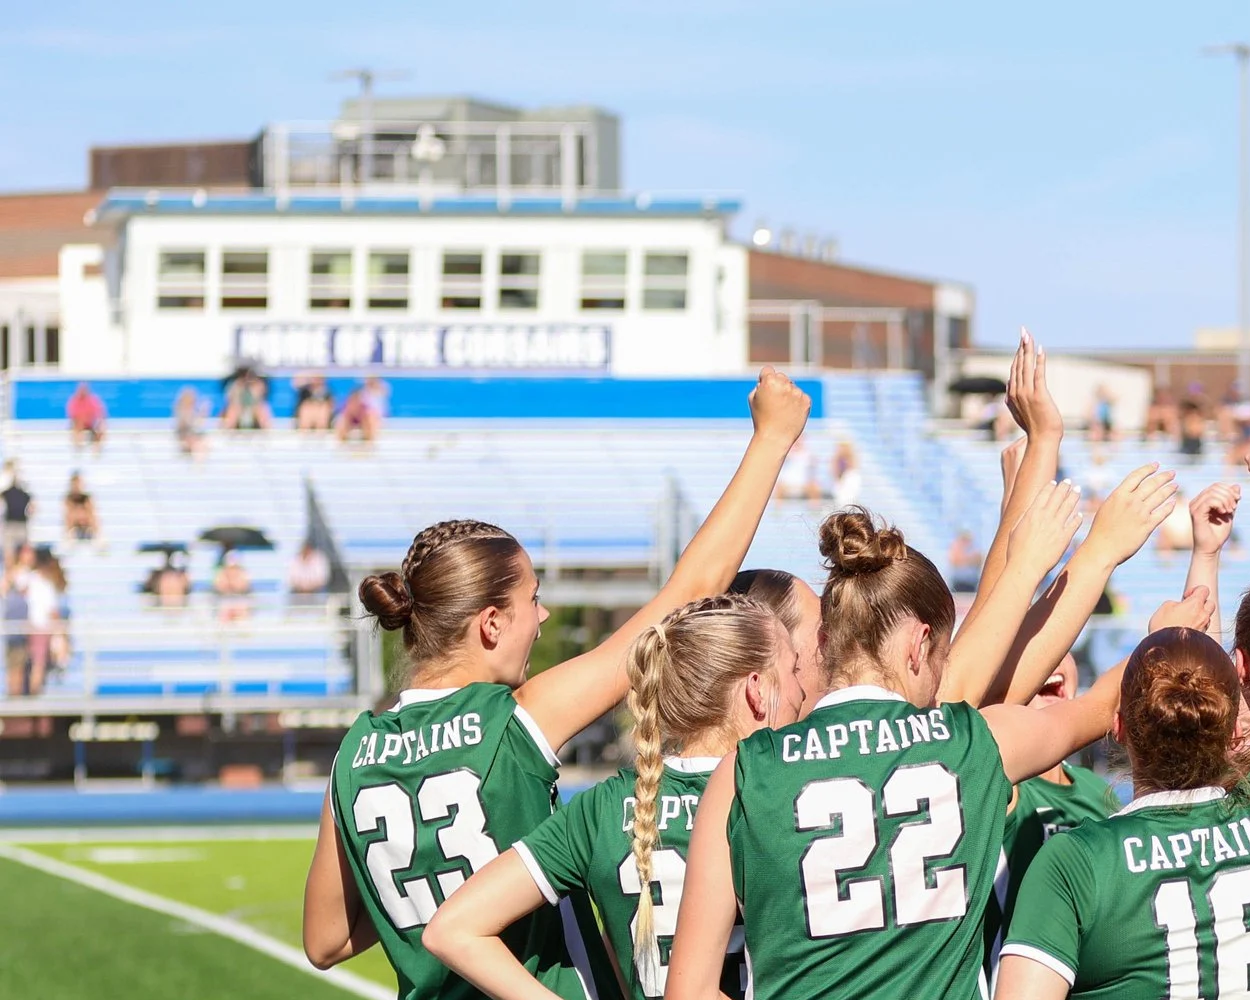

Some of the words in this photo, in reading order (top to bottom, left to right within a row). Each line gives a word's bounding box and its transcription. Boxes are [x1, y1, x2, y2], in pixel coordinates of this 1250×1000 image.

[352, 712, 482, 769] CAPTAINS
[781, 709, 951, 763] CAPTAINS
[352, 766, 500, 932] 23
[622, 794, 699, 833] CPT
[793, 760, 969, 940] 22
[617, 847, 687, 998] 2
